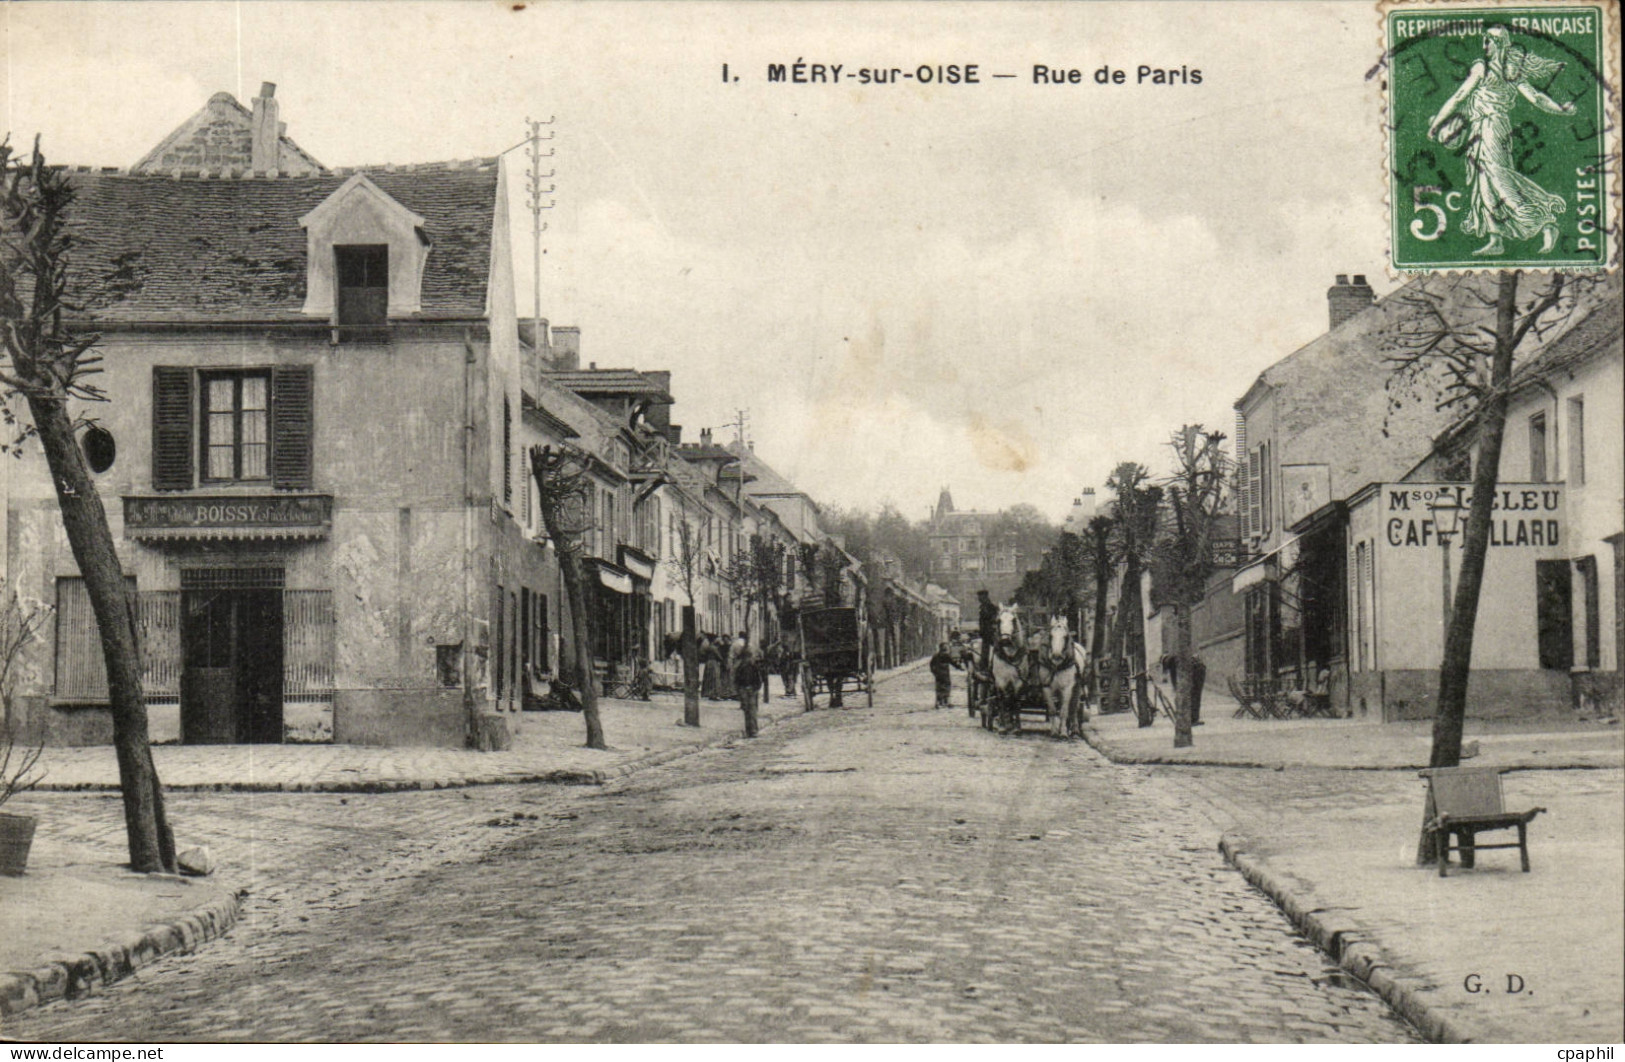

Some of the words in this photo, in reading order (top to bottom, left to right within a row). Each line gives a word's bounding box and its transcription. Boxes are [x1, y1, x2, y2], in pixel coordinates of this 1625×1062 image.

[1511, 16, 1593, 37] FRANÇAISE
[1576, 167, 1597, 249] POSTES
[197, 505, 259, 522] BOISSY
